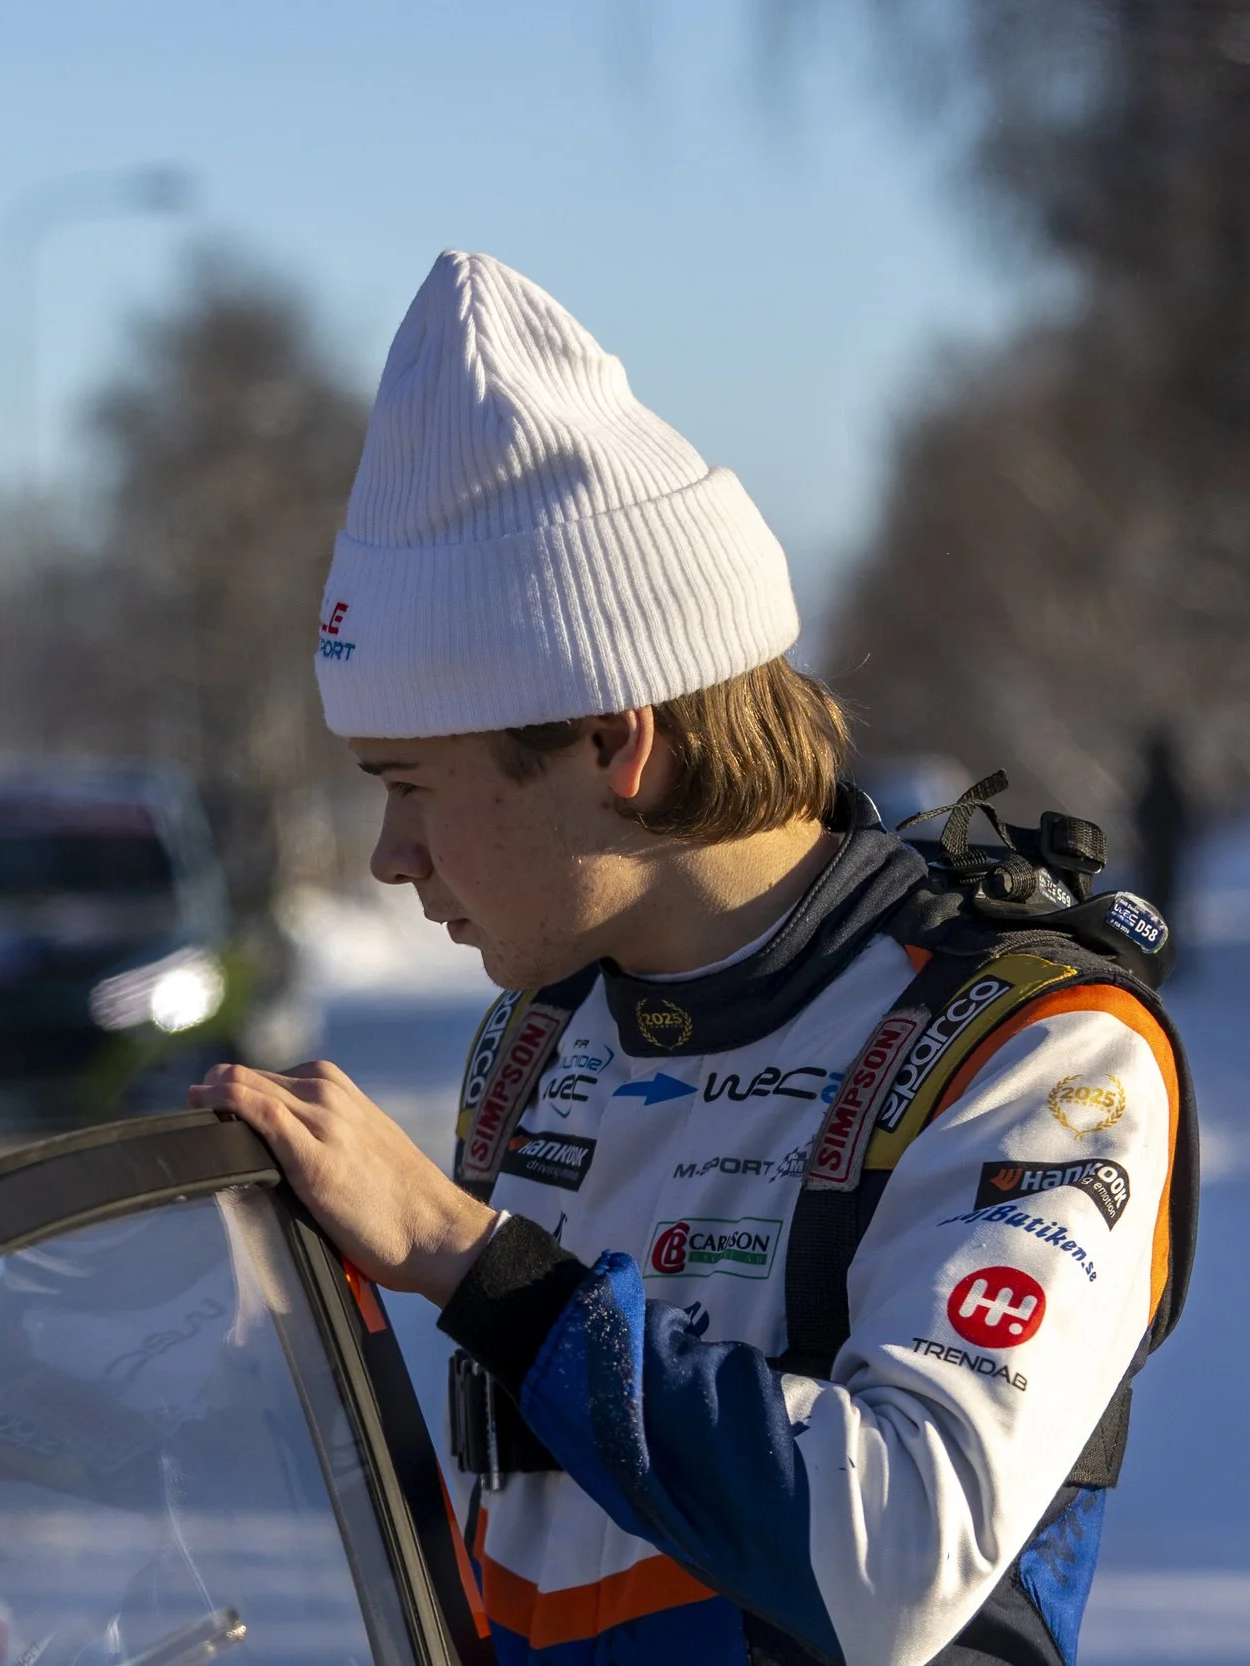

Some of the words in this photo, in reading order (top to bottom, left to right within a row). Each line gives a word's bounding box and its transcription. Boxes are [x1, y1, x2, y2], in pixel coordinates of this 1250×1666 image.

[1134, 919, 1158, 942] D58
[642, 1012, 683, 1025] 2025
[470, 1021, 548, 1162] SIMPSON
[817, 1027, 902, 1172] SIMPSON
[1059, 1086, 1116, 1108] 2025
[912, 1337, 1028, 1392] TRENDAB
